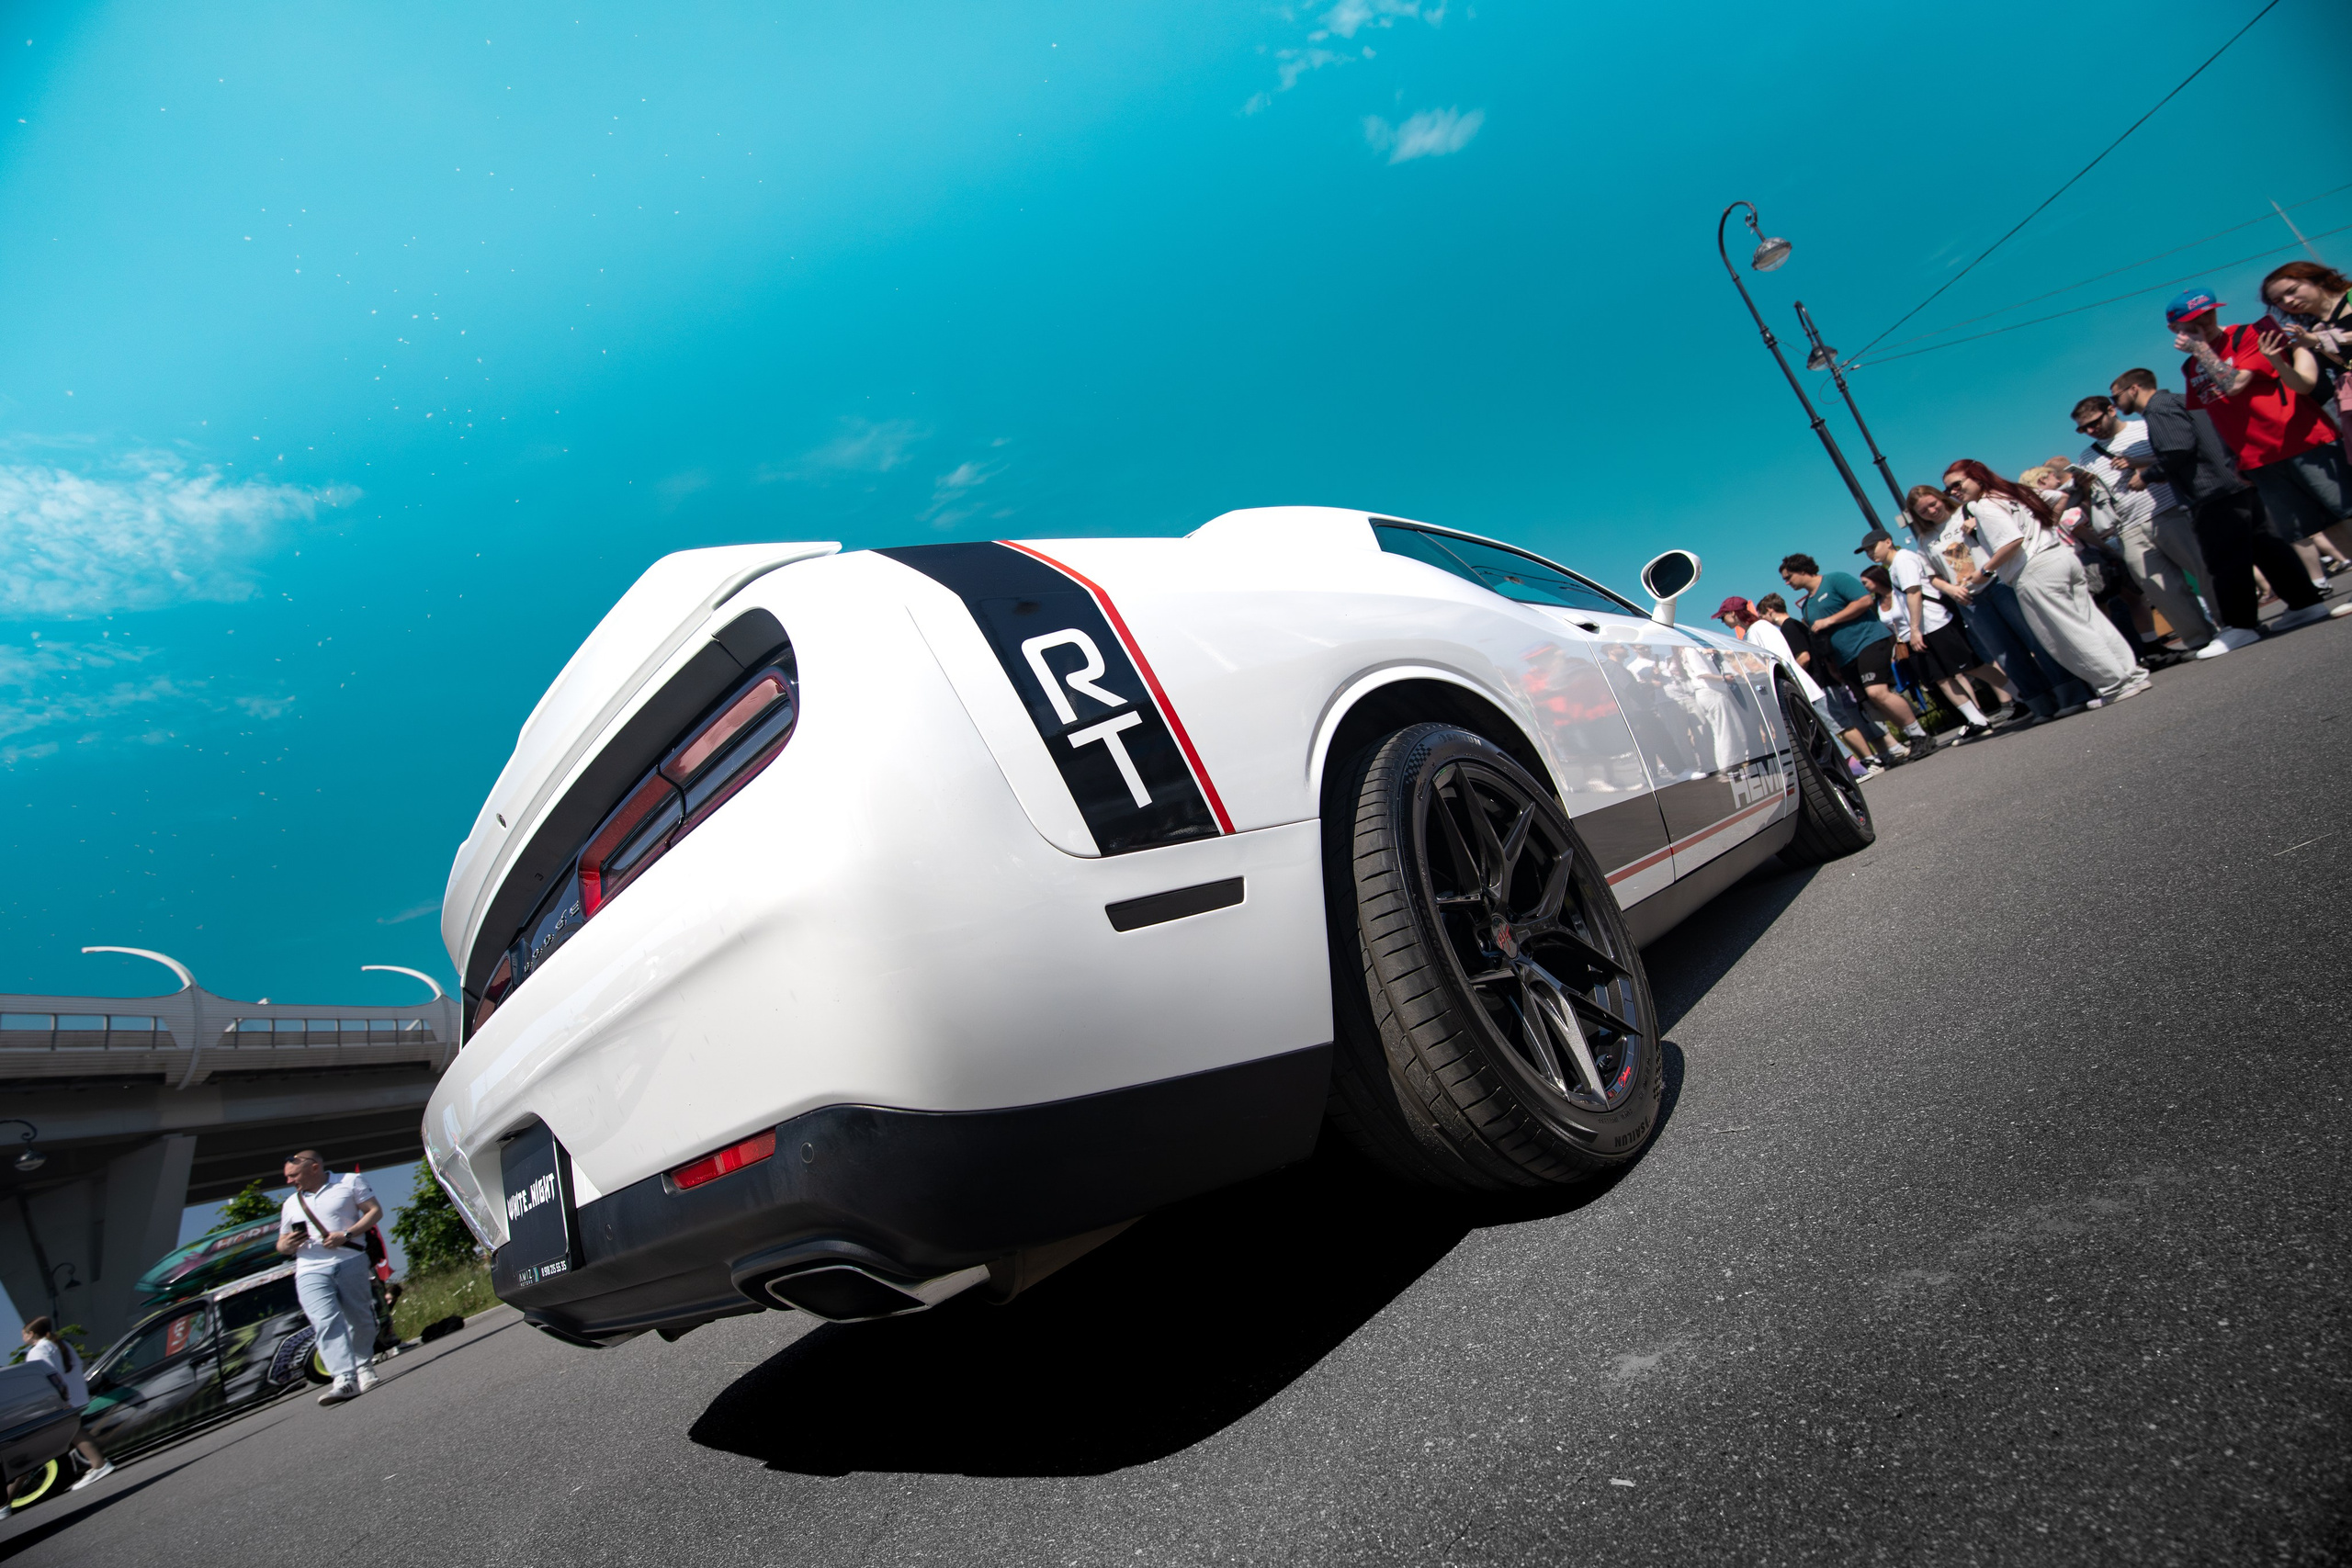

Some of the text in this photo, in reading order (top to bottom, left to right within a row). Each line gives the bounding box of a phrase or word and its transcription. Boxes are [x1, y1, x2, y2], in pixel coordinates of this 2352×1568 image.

[1727, 755, 1784, 810] HEMI
[1614, 1122, 1646, 1148] SAILUN
[519, 1269, 533, 1282] AMIZ
